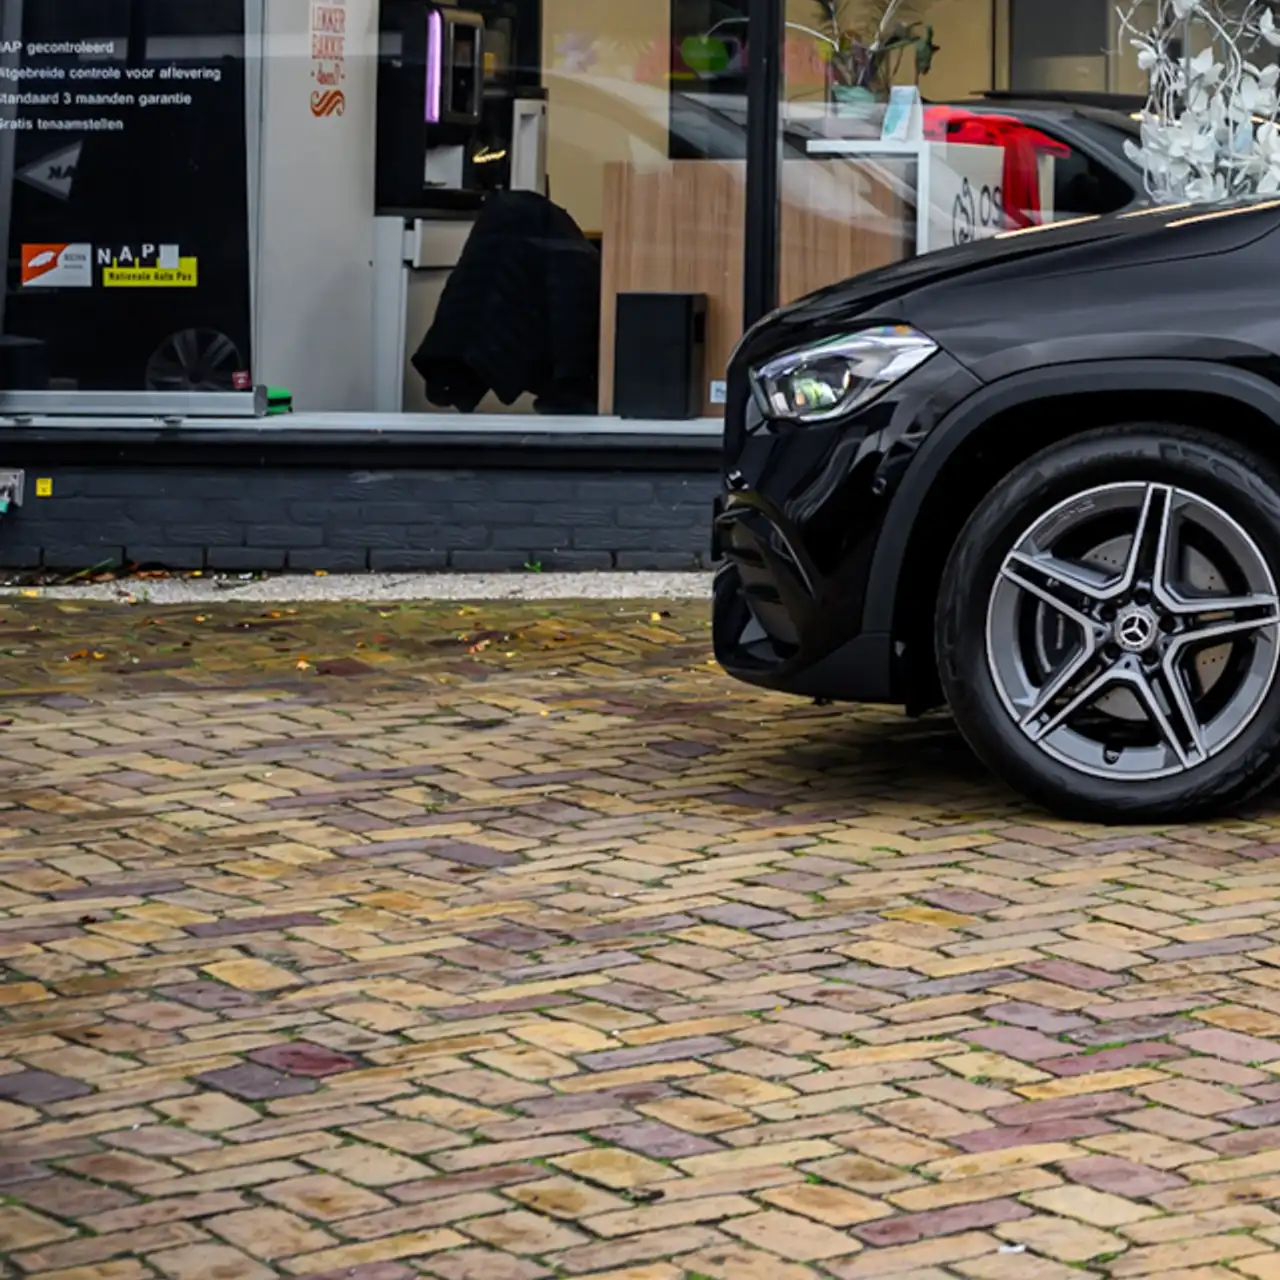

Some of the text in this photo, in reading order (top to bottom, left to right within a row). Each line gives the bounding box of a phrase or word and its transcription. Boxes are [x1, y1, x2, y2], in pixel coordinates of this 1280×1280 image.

[0, 41, 115, 56] AP gecontroleerd
[69, 66, 121, 80] controle
[125, 68, 155, 79] voor
[159, 66, 221, 82] aflevering
[0, 91, 192, 107] tandaard 3 maanden garantie
[37, 117, 124, 131] tenaamstellen
[97, 244, 155, 266] NAP
